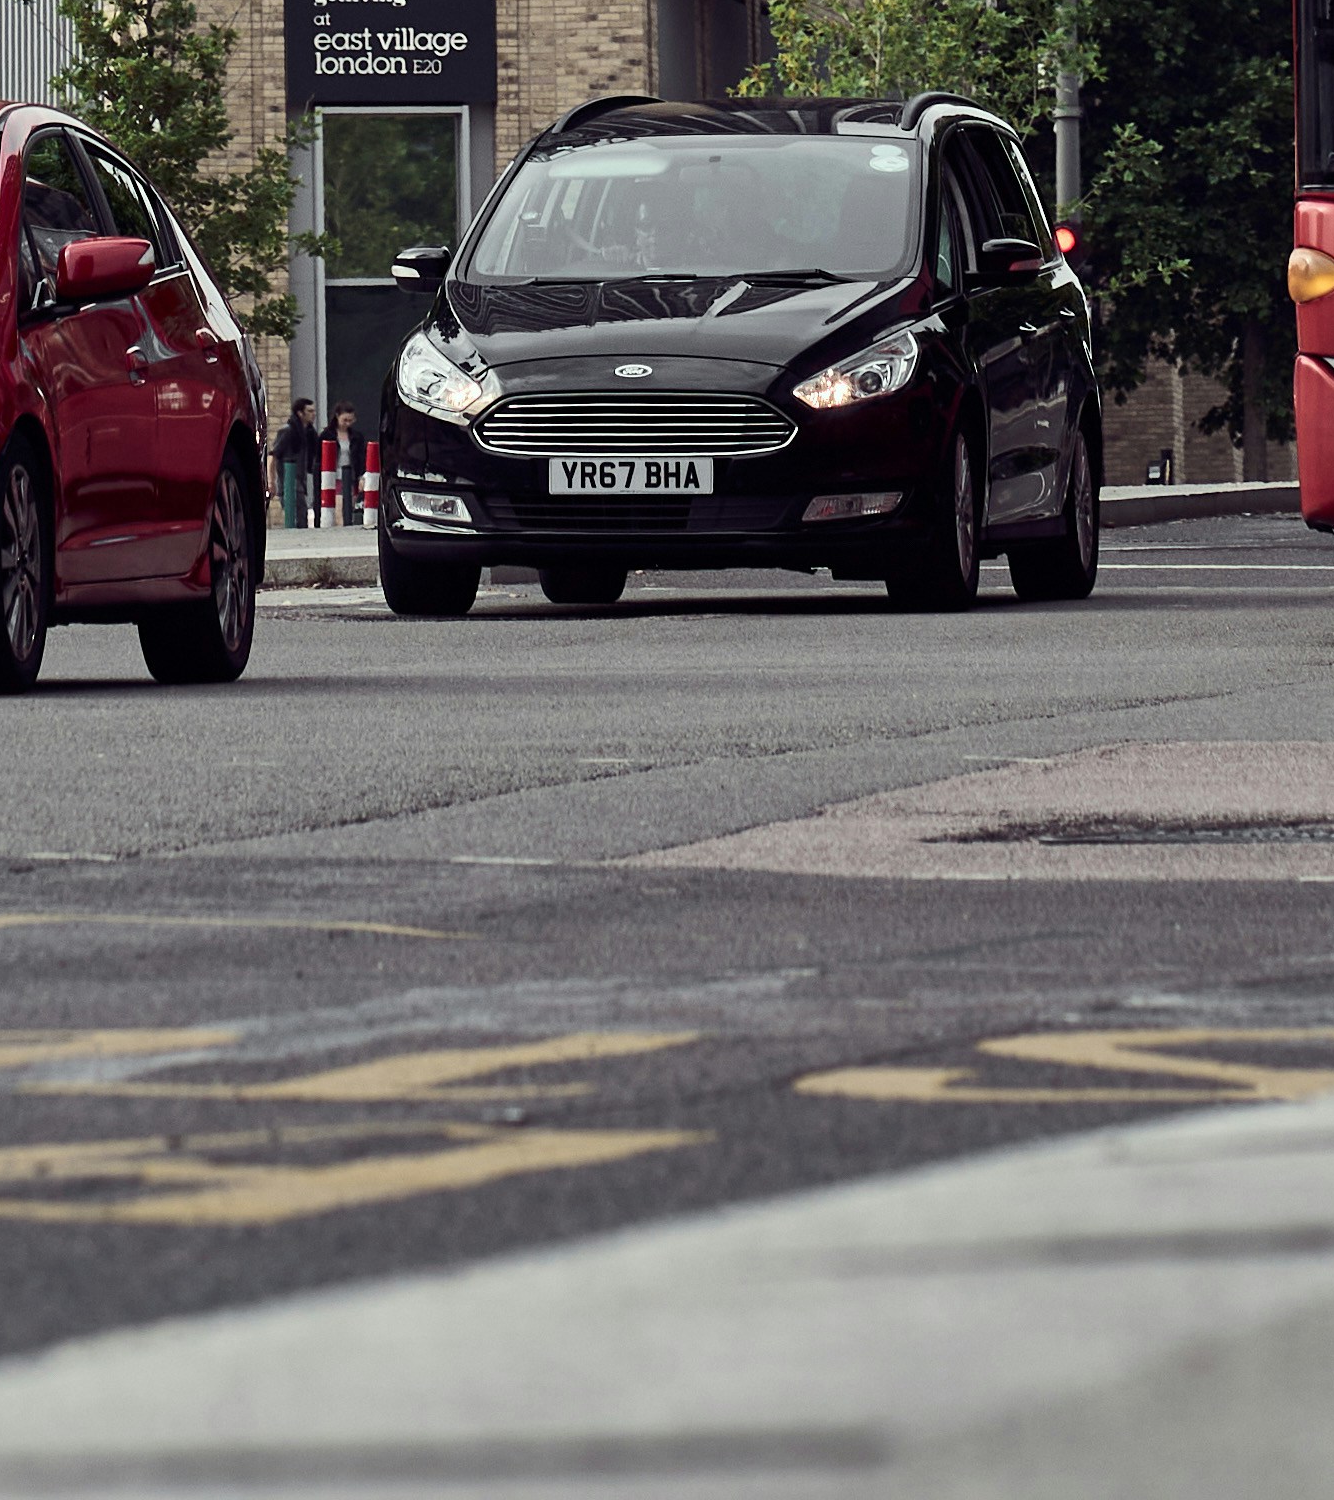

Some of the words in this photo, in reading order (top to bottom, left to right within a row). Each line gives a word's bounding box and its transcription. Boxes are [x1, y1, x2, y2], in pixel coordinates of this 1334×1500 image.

[313, 12, 331, 26] at
[313, 27, 372, 51] east
[376, 27, 468, 58] village
[314, 51, 407, 75] london
[412, 58, 442, 75] E20
[561, 461, 636, 489] YR67
[644, 461, 700, 489] BHA
